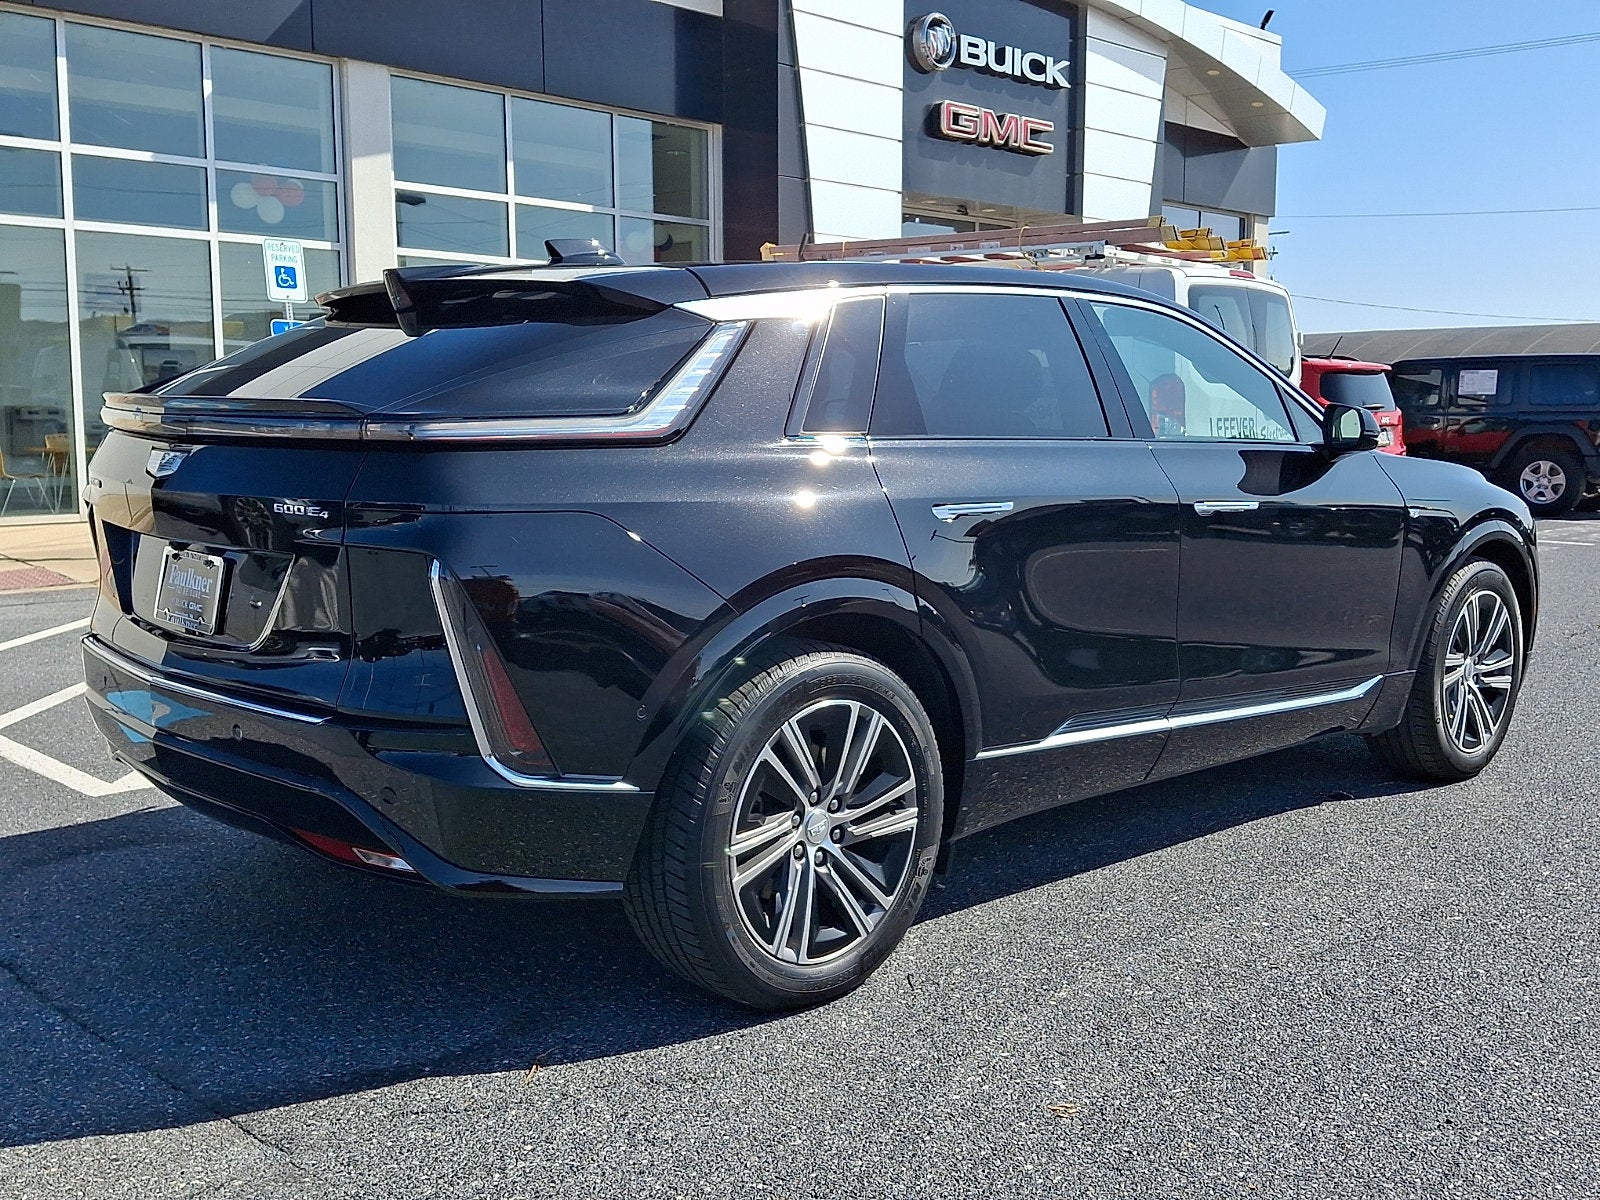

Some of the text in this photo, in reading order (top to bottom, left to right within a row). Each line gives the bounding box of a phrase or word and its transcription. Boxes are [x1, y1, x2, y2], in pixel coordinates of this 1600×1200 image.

[960, 34, 1071, 88] BUICK
[941, 99, 1054, 153] GMC
[266, 243, 300, 254] RESERVED
[270, 253, 298, 264] PARKING
[168, 564, 213, 593] Faulkner
[189, 601, 203, 612] GMC
